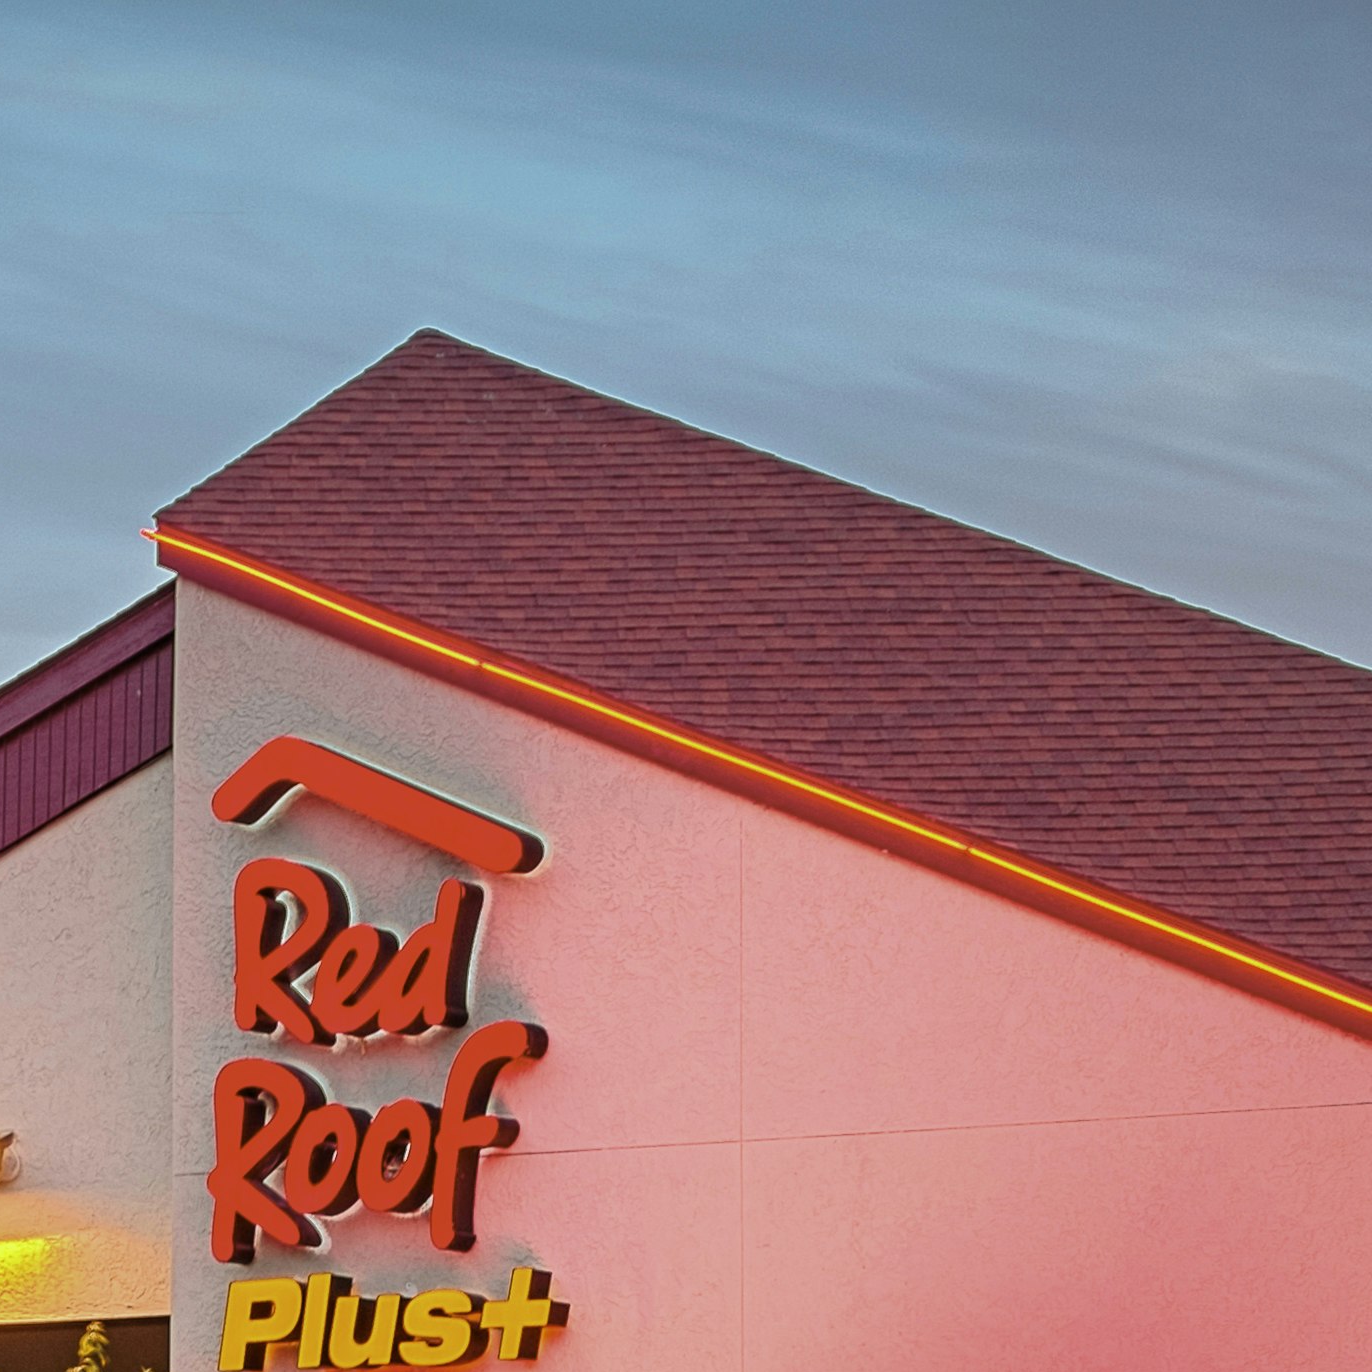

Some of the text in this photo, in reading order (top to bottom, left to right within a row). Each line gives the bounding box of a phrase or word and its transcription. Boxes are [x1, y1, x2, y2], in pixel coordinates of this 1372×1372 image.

[233, 857, 476, 1046] Red
[207, 1020, 536, 1263] Roof
[218, 1267, 556, 1372] Plus+
